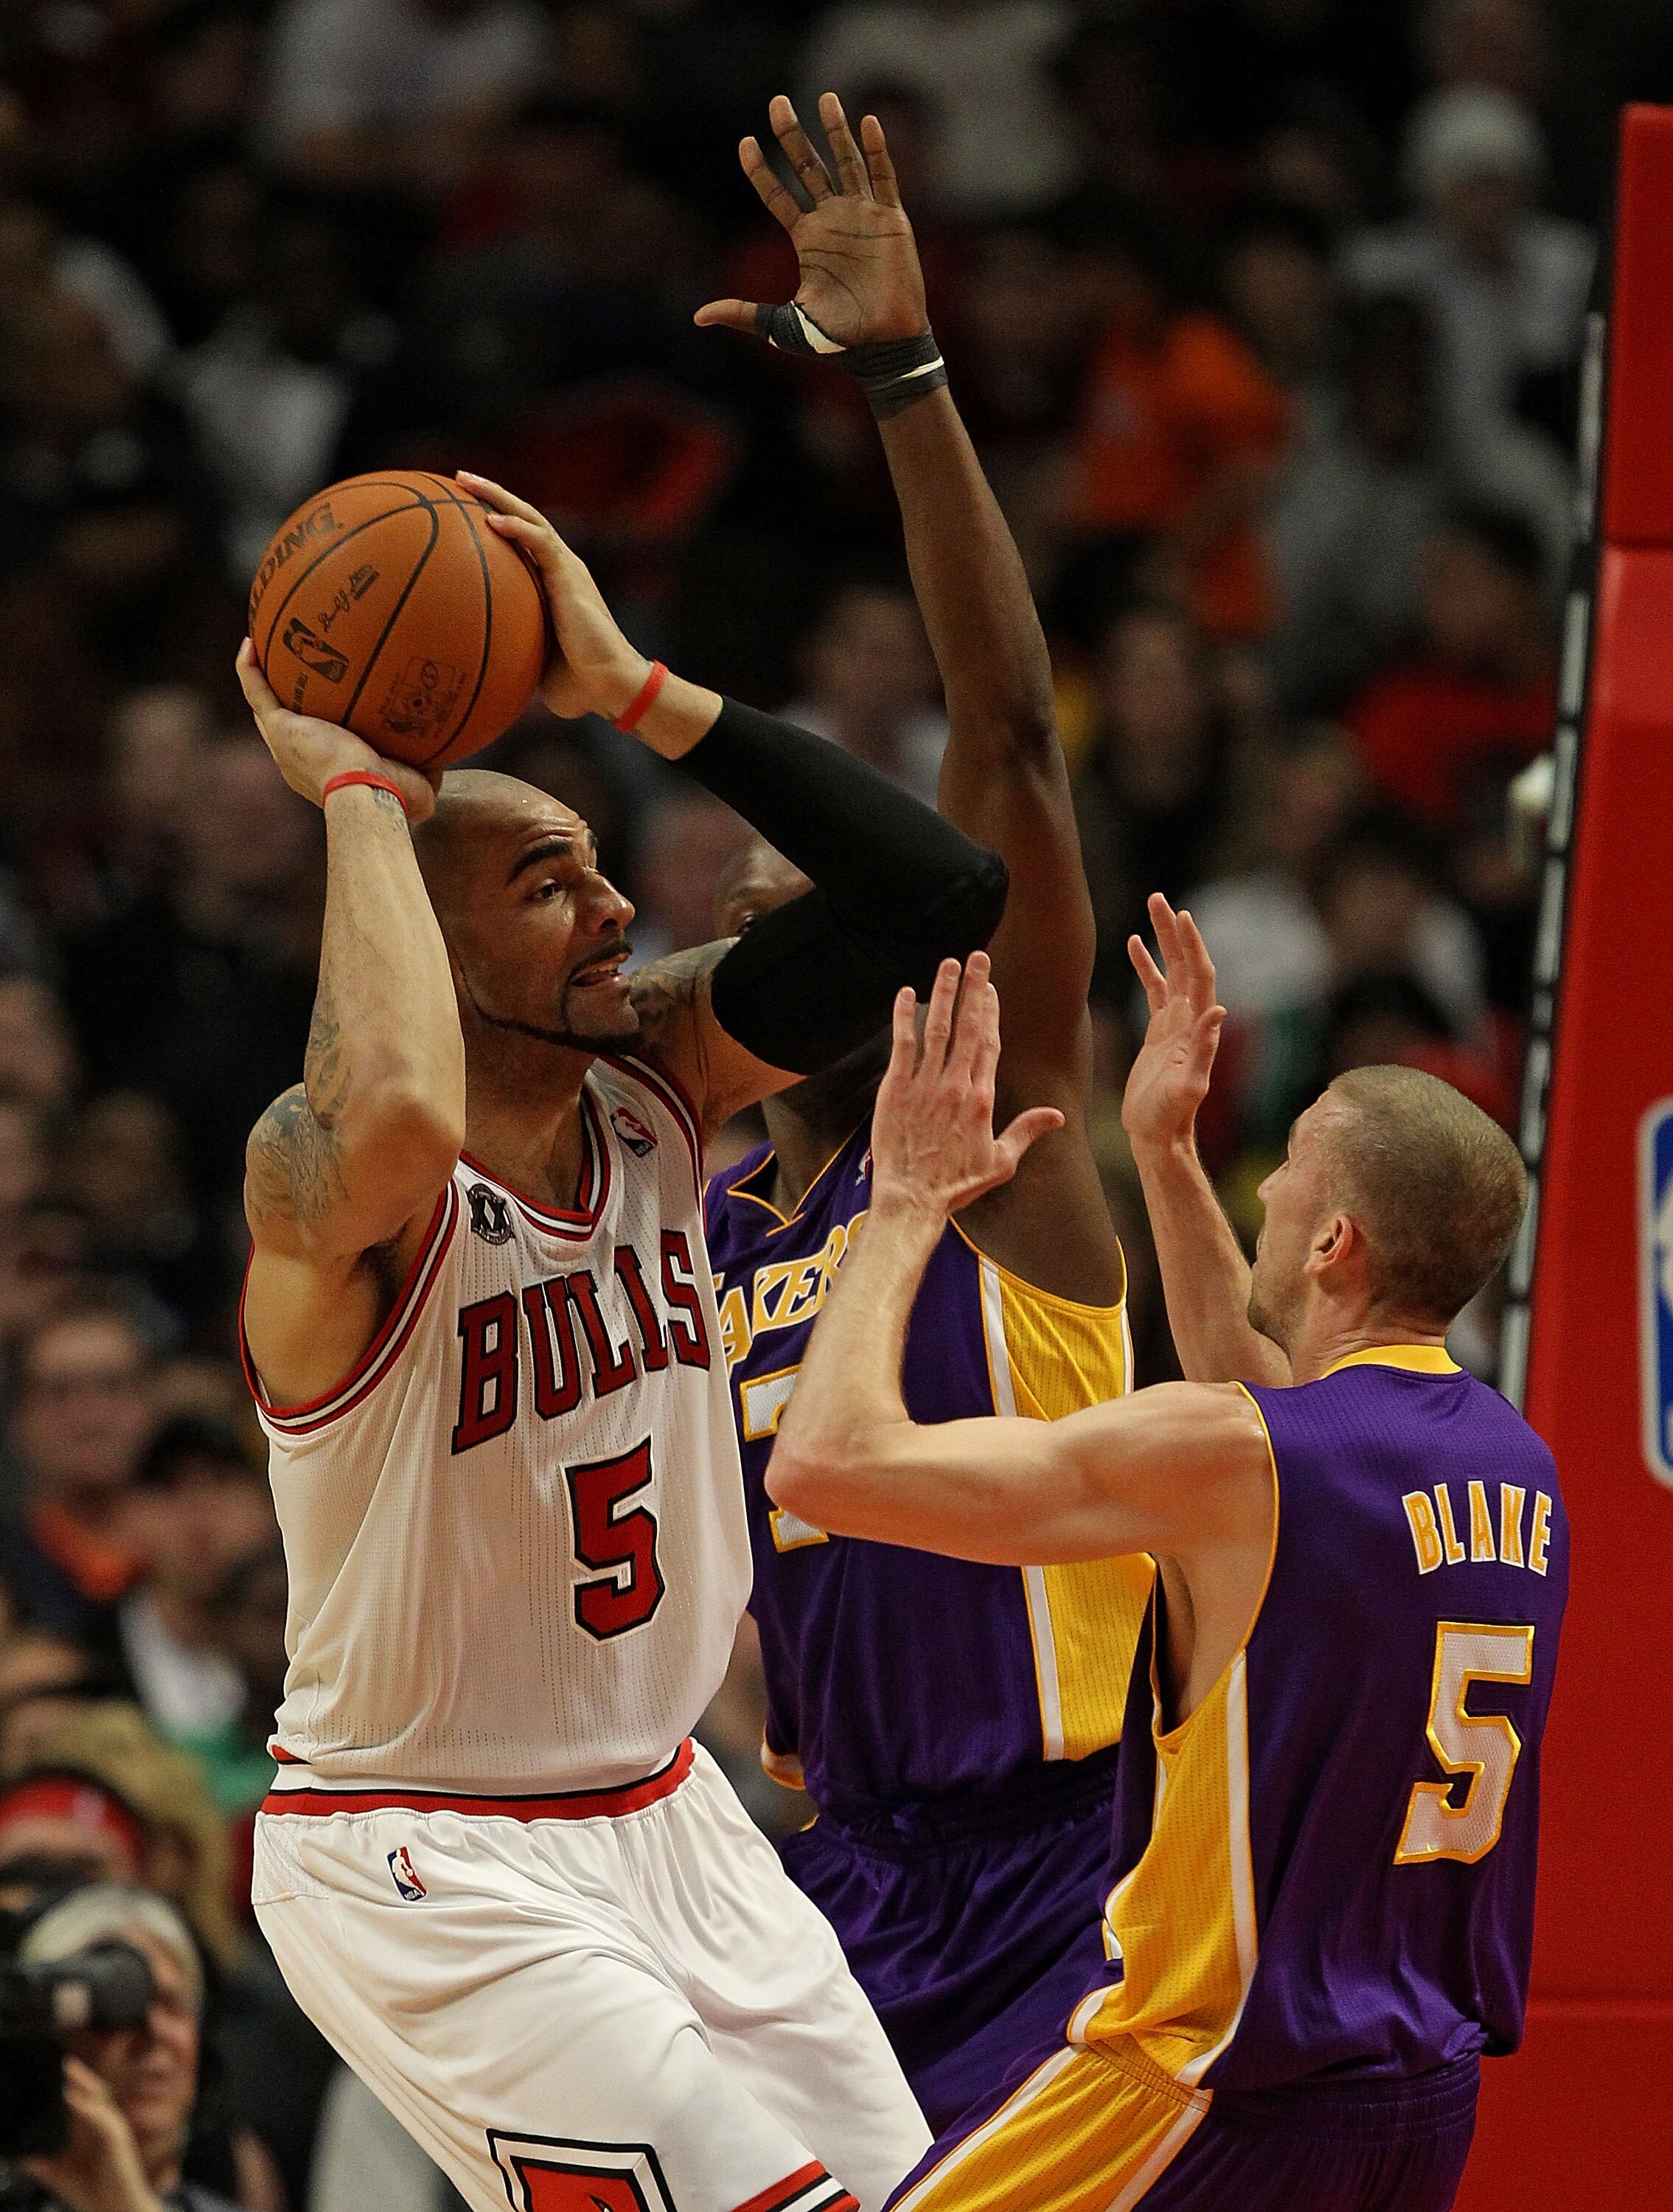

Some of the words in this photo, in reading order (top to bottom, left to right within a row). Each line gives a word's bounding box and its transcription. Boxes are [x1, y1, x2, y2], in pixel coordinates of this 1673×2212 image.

[451, 1228, 710, 1455] BULLS
[713, 1210, 869, 1380] AKER
[560, 1435, 666, 1646] 5
[1402, 1480, 1552, 1576] BLAKE
[1392, 1621, 1535, 1865] 5
